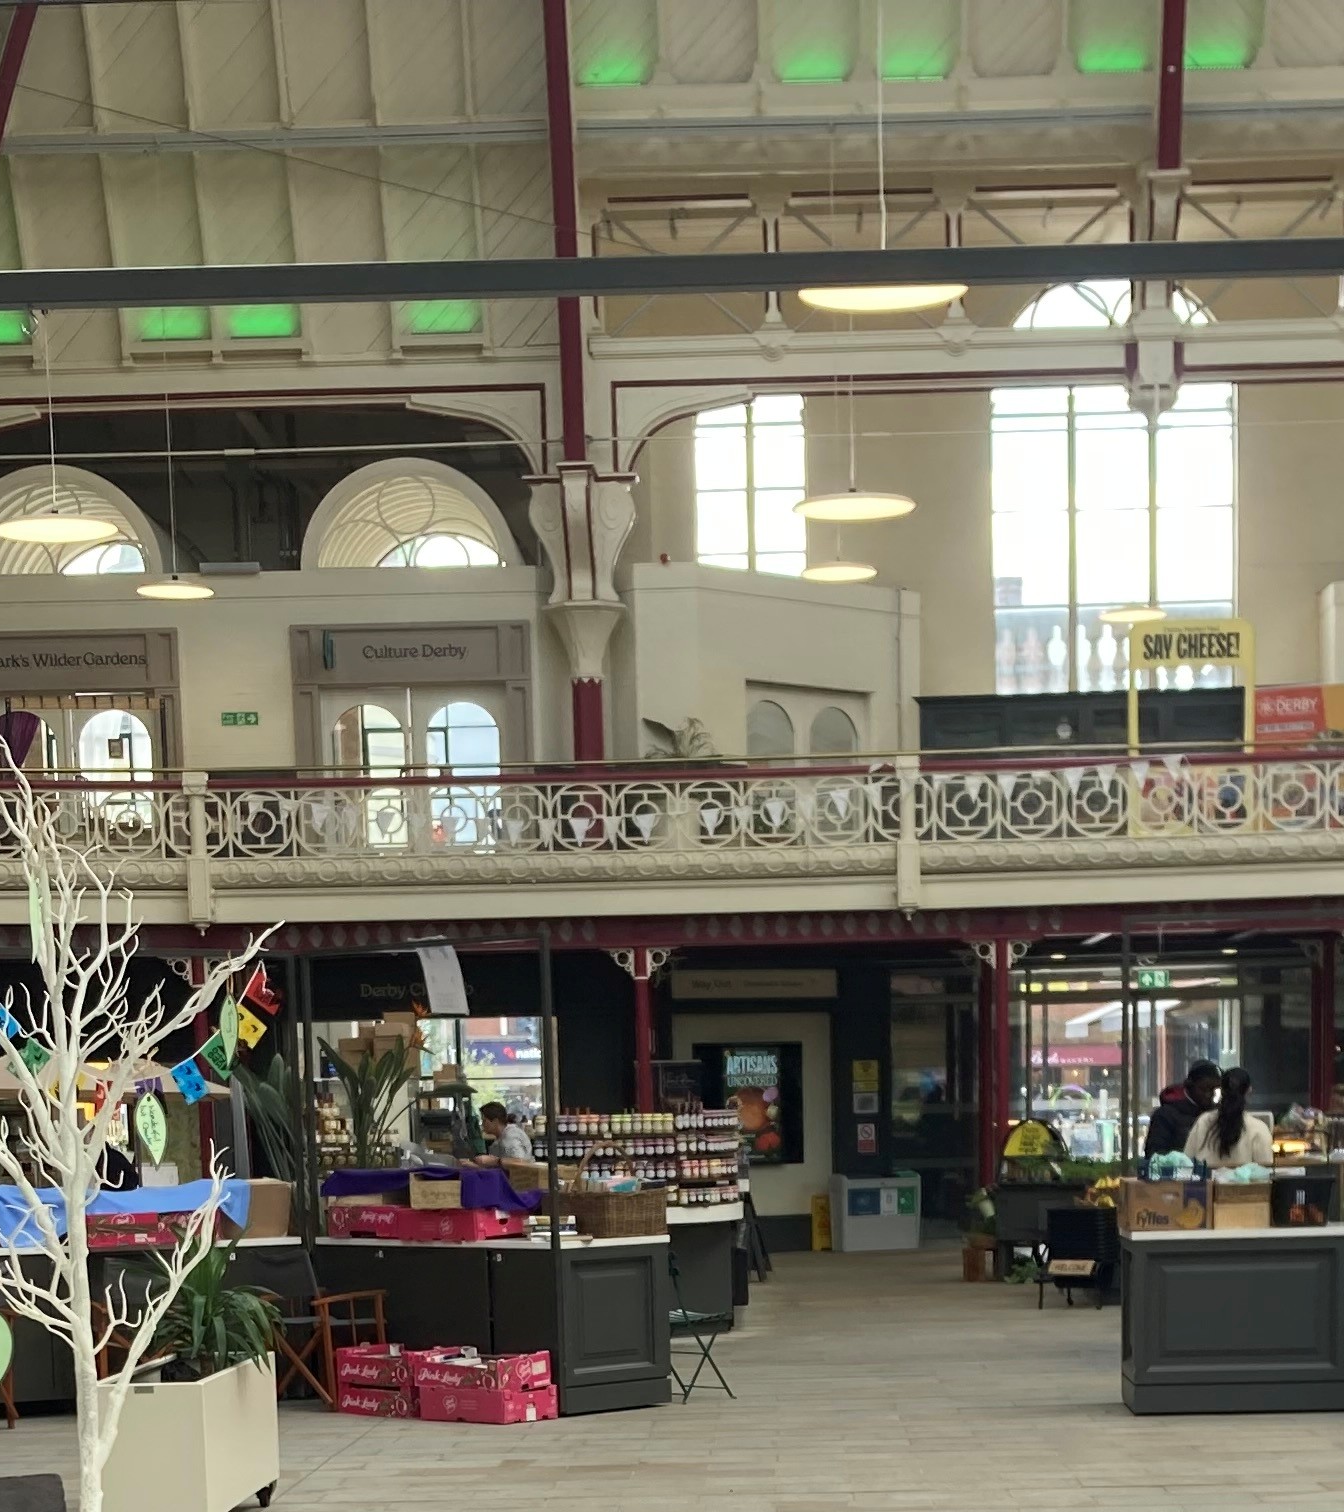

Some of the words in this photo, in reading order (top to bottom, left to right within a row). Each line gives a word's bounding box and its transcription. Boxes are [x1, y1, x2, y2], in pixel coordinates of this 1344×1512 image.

[361, 643, 416, 661] Culture
[419, 643, 469, 662] Derby
[1143, 632, 1172, 660] SAY
[1177, 632, 1240, 659] CHEESE!
[31, 651, 81, 670] Wilder
[83, 649, 148, 670] Gardens
[1276, 696, 1318, 713] DERBY
[360, 983, 406, 999] Derby
[726, 1055, 778, 1075] ARTISANS
[341, 1362, 360, 1377] Pink
[361, 1363, 381, 1380] Lady
[418, 1367, 439, 1381] Pink
[440, 1369, 463, 1384] Lady
[342, 1394, 360, 1407] Pink
[361, 1395, 381, 1411] Lady
